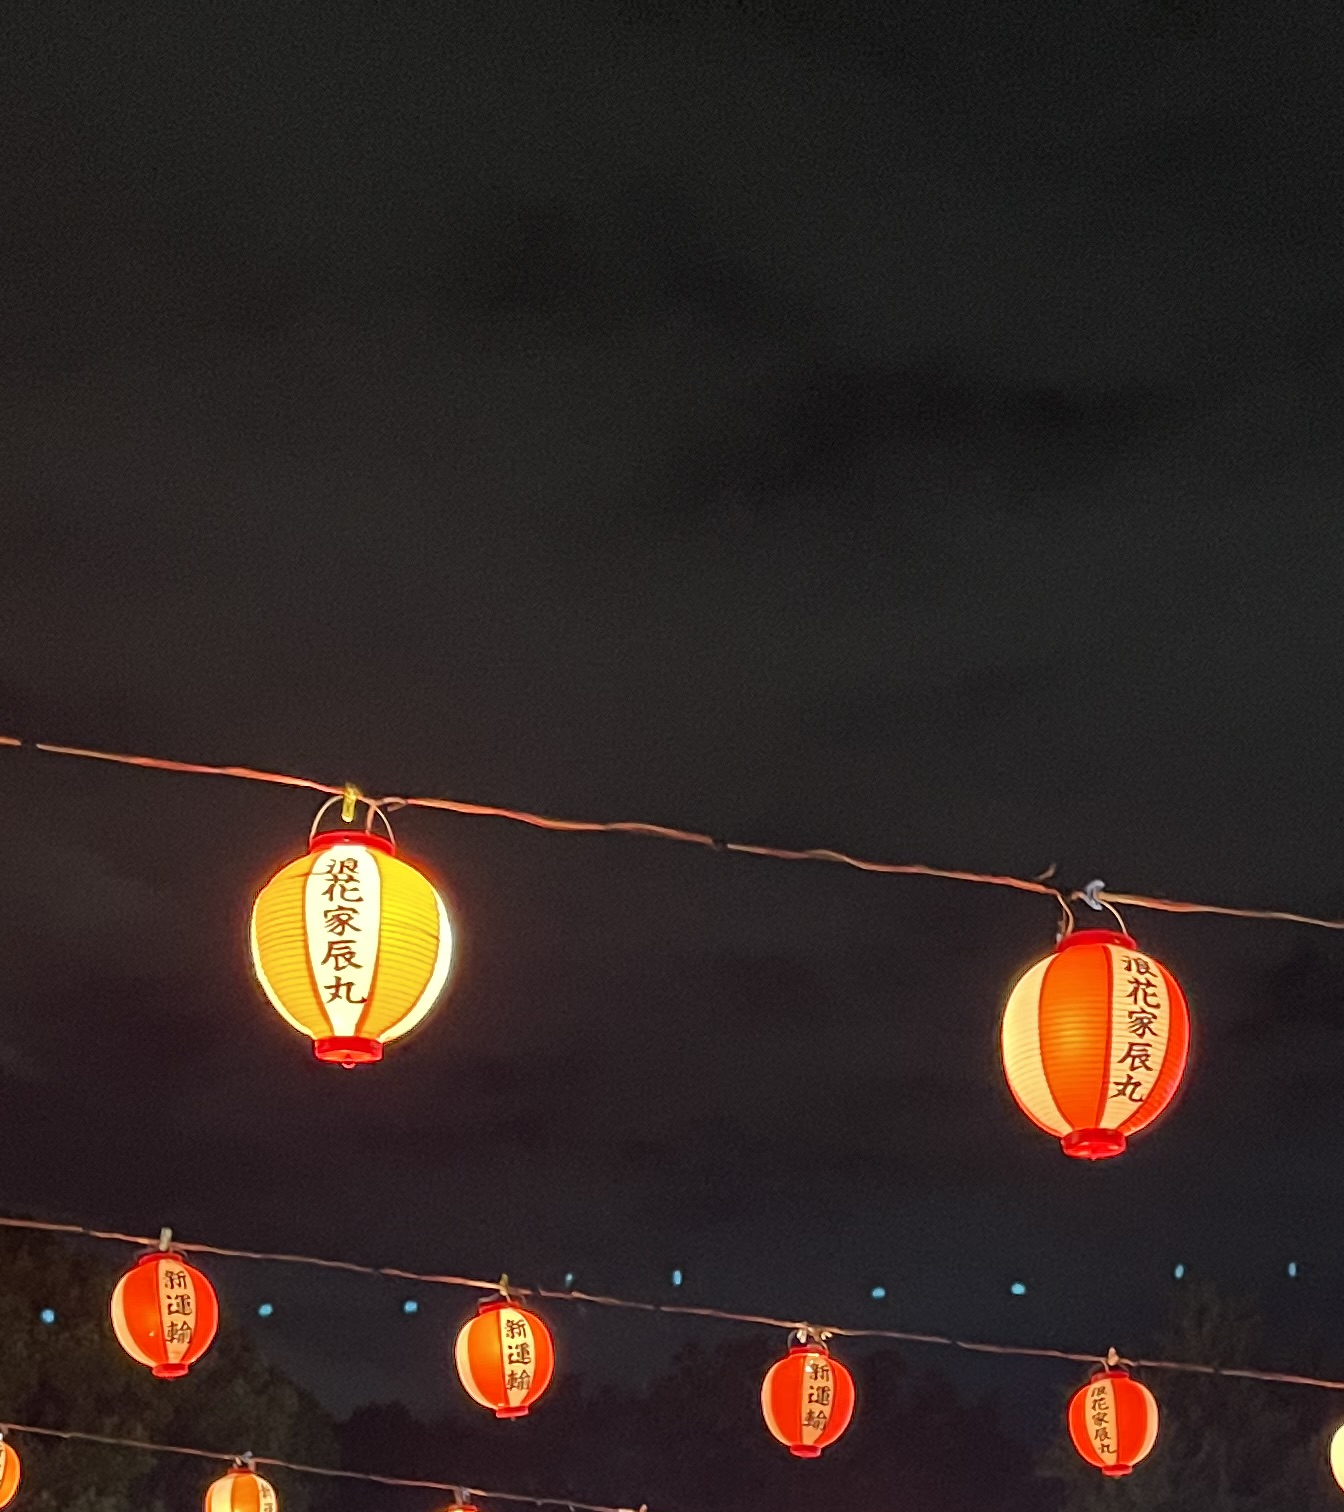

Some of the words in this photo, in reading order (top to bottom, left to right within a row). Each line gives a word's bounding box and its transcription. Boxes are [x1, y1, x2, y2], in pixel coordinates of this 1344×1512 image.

[320, 857, 368, 1005] 浪花家辰丸
[1108, 955, 1162, 1103] 浪花家辰丸
[164, 1269, 193, 1344] 新運輸
[505, 1318, 532, 1391] 新運輸
[801, 1362, 831, 1430] 新運輸
[1090, 1385, 1117, 1454] 浪花家辰丸
